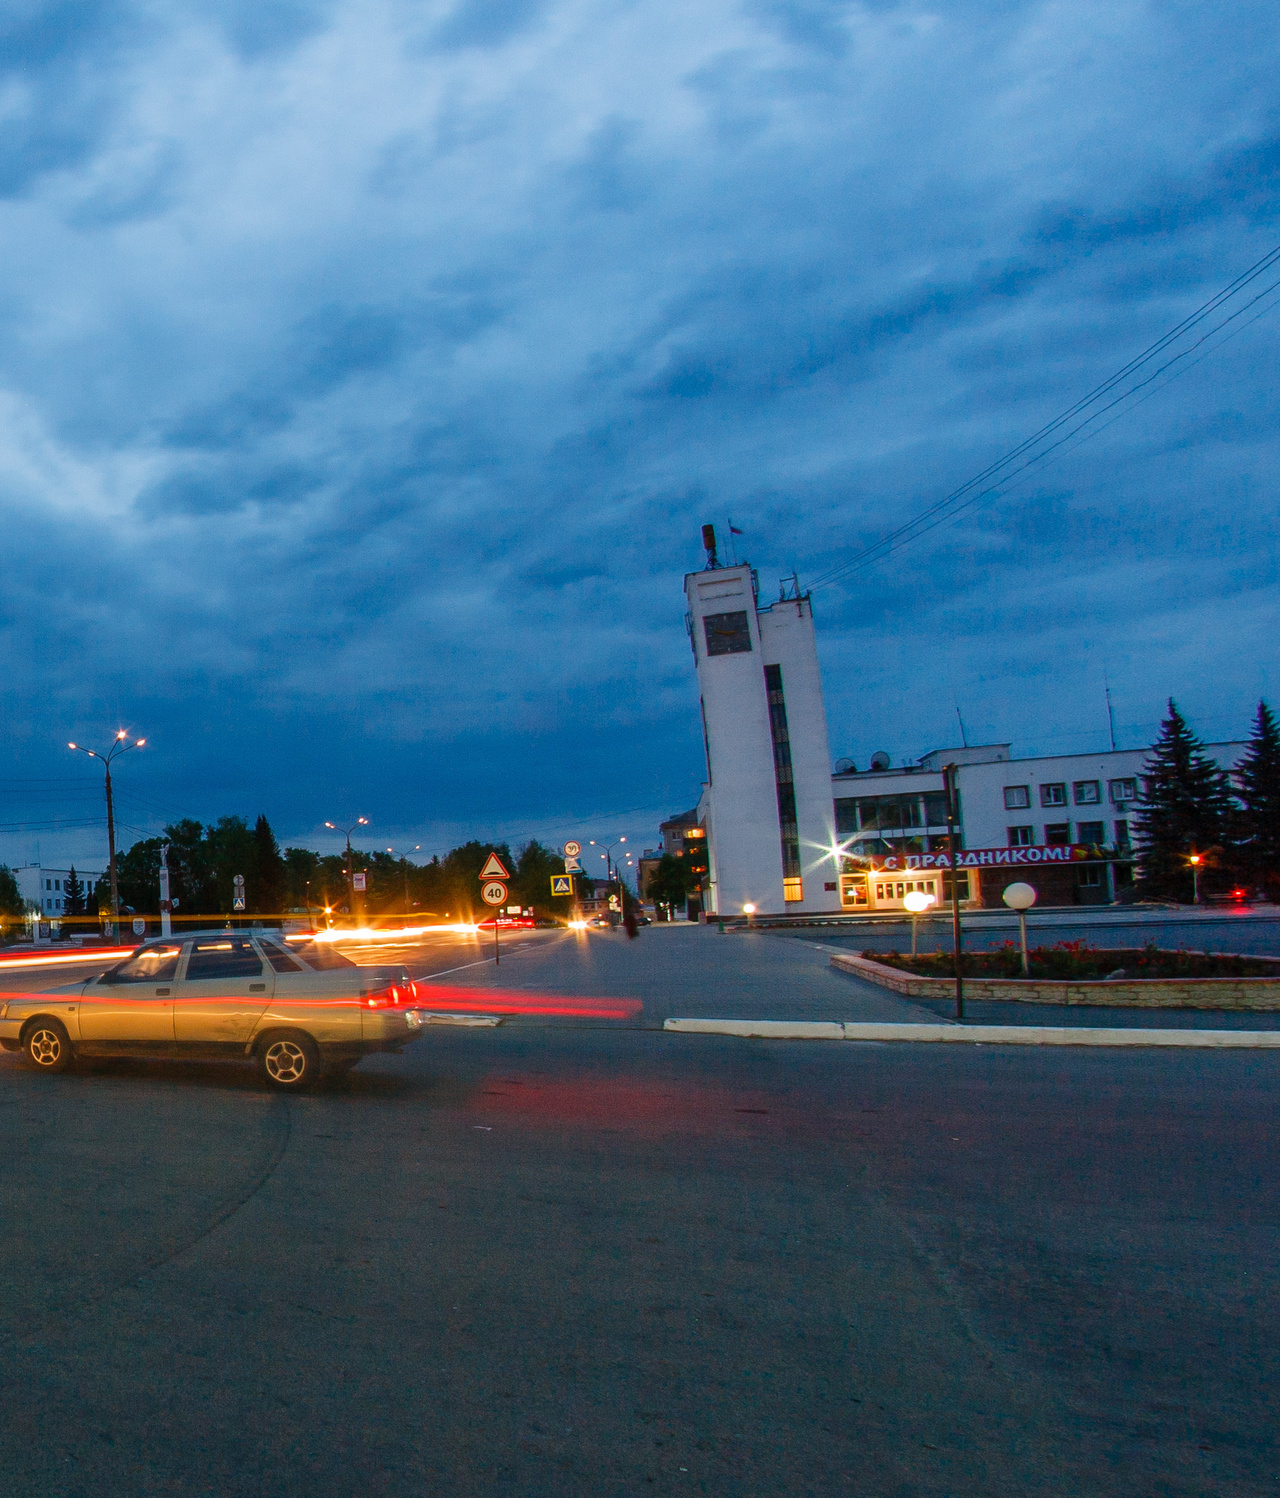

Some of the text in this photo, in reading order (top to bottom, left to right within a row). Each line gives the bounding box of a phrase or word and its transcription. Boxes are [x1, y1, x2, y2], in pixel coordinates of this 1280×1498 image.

[884, 847, 1070, 869] С ПРАЗДНИКОМ!
[487, 888, 501, 898] 40
